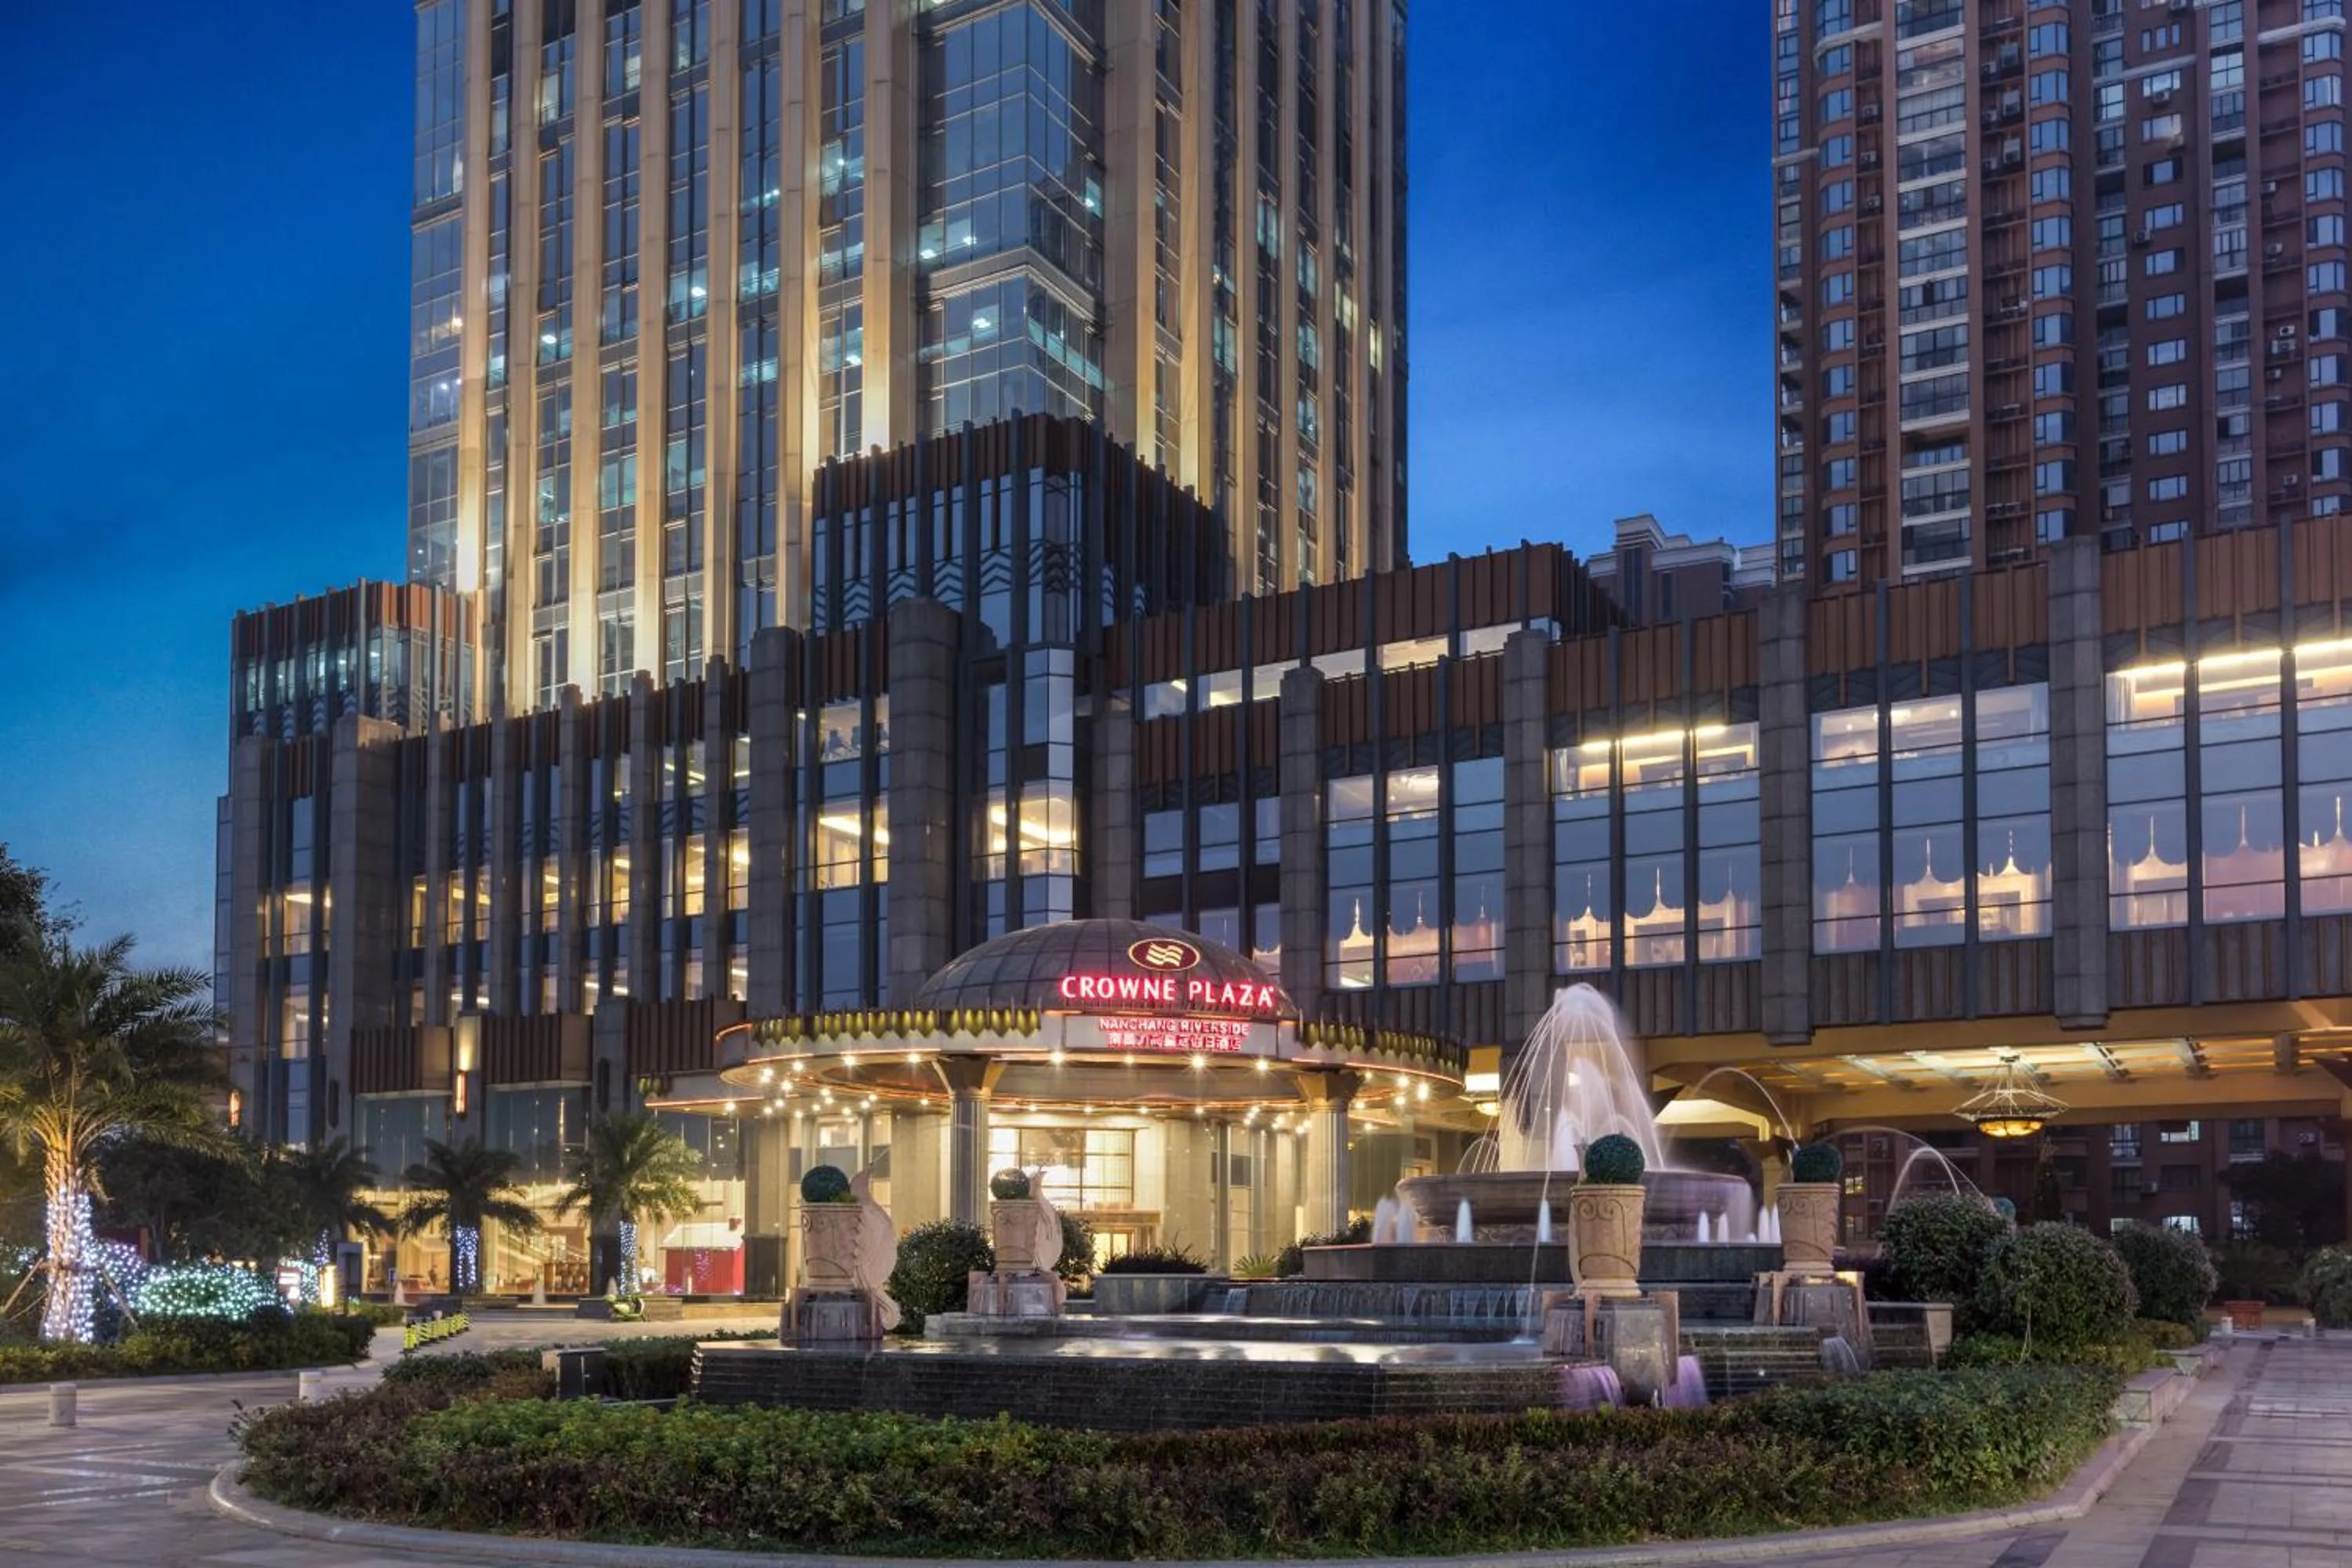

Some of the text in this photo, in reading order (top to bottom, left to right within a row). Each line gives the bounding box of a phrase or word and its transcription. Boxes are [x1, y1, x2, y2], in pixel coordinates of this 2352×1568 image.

[1062, 975, 1273, 1008] CROWNE PLAZA
[1099, 1018, 1250, 1036] NANCHANG RIVERSIDE
[1109, 1032, 1241, 1051] 南力高假日酒店
